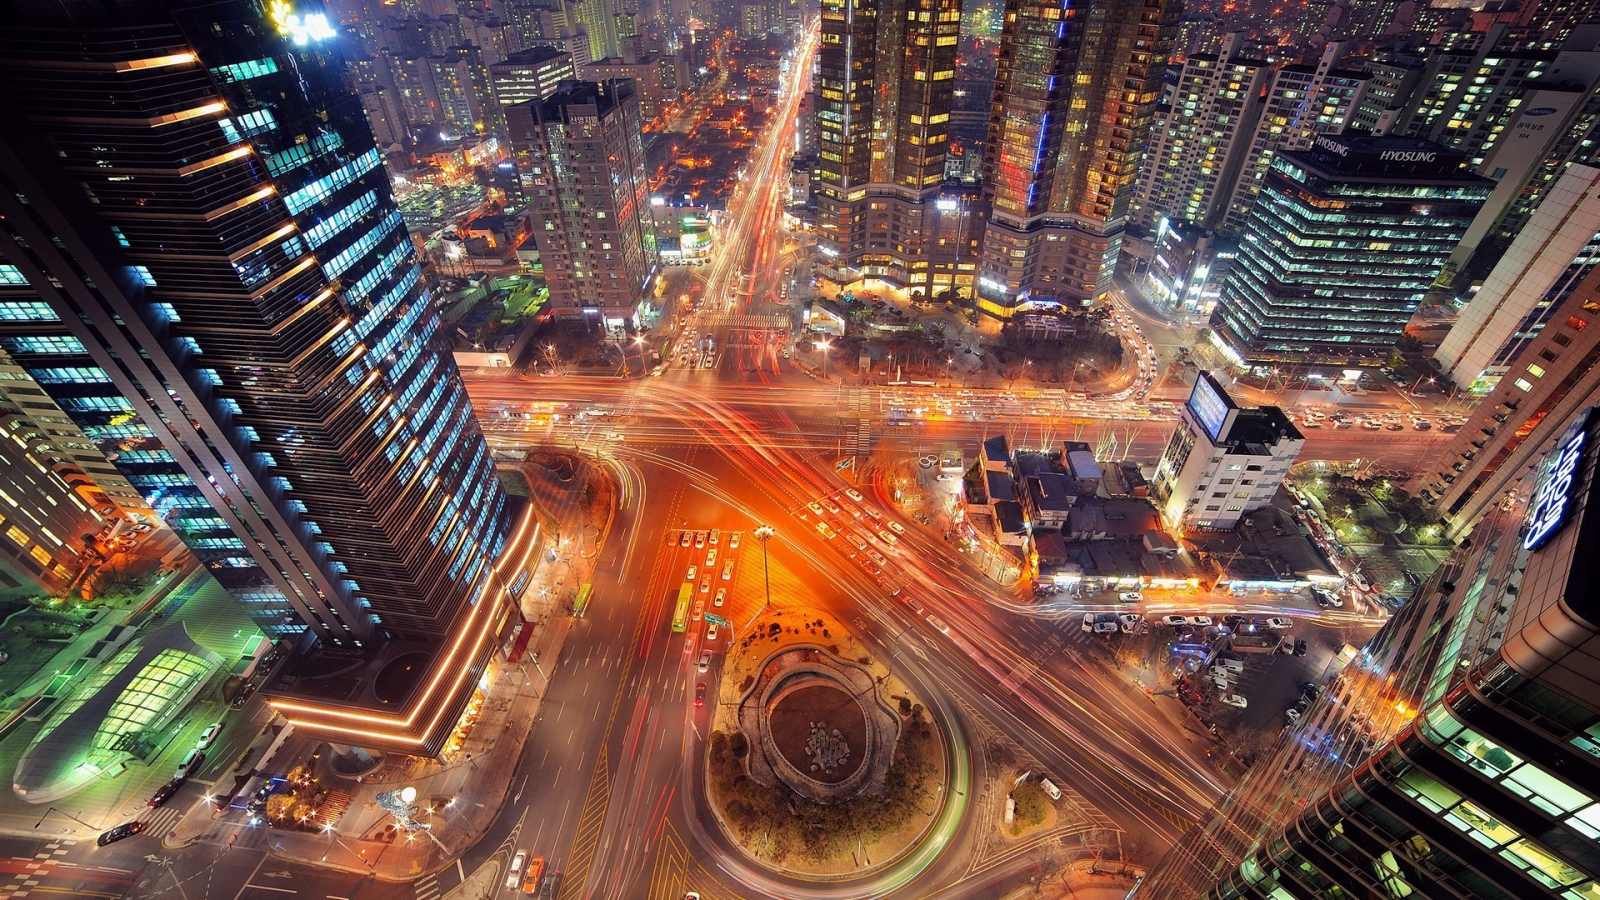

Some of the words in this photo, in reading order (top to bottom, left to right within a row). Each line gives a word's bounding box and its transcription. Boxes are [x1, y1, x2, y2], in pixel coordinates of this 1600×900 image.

[1517, 121, 1545, 131] 공덕삼성
[1315, 135, 1349, 157] HYOSUNG
[1380, 150, 1437, 162] HYOSUNG
